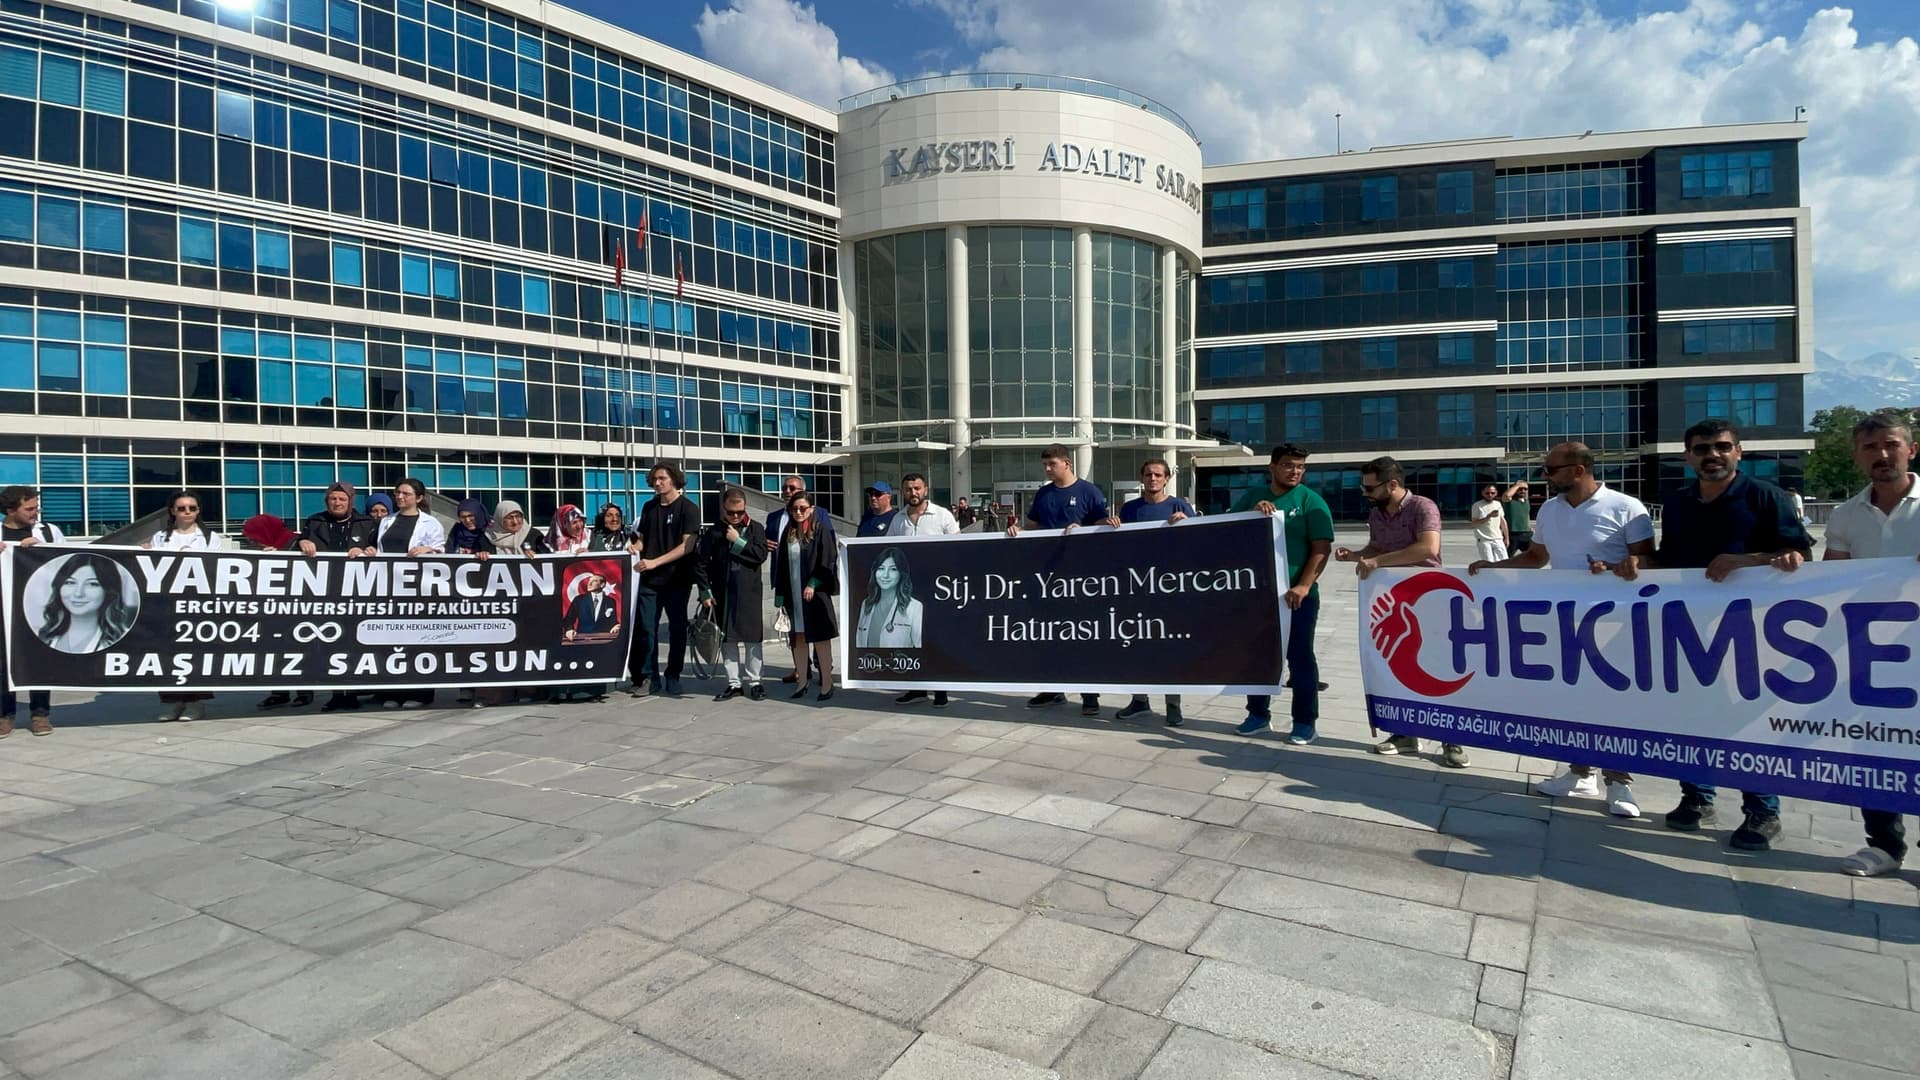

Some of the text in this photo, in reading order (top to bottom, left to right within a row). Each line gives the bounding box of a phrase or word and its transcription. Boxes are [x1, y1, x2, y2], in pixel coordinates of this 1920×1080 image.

[887, 135, 1016, 178] KAYSERİ
[1038, 141, 1146, 184] ADALET
[136, 555, 555, 597] YAREN MERCAN
[934, 566, 1257, 609] Stj. Dr. Yaren Mercan
[175, 597, 517, 615] ERCİYES ÜNİVERSİTESİ TIP FAKÜLTESİ
[175, 620, 260, 643] 2004
[453, 623, 481, 631] EMANET
[987, 607, 1191, 647] Hatırası İçin...
[105, 652, 304, 685] BAŞIMIZ
[857, 656, 882, 670] 2004
[892, 657, 921, 671] 2026
[1374, 702, 1399, 721] HEKİM
[1402, 707, 1415, 723] VE
[1418, 707, 1454, 729] DİĞER
[1457, 714, 1500, 737] SAĞLIK
[1504, 723, 1589, 750] ÇALIŞANLARI
[1594, 734, 1637, 758] KAMU
[1642, 738, 1700, 766] SAĞLIK
[1705, 747, 1725, 769] VE
[1730, 751, 1796, 779] SOSYAL
[1802, 756, 1907, 793] HİZMETLER
